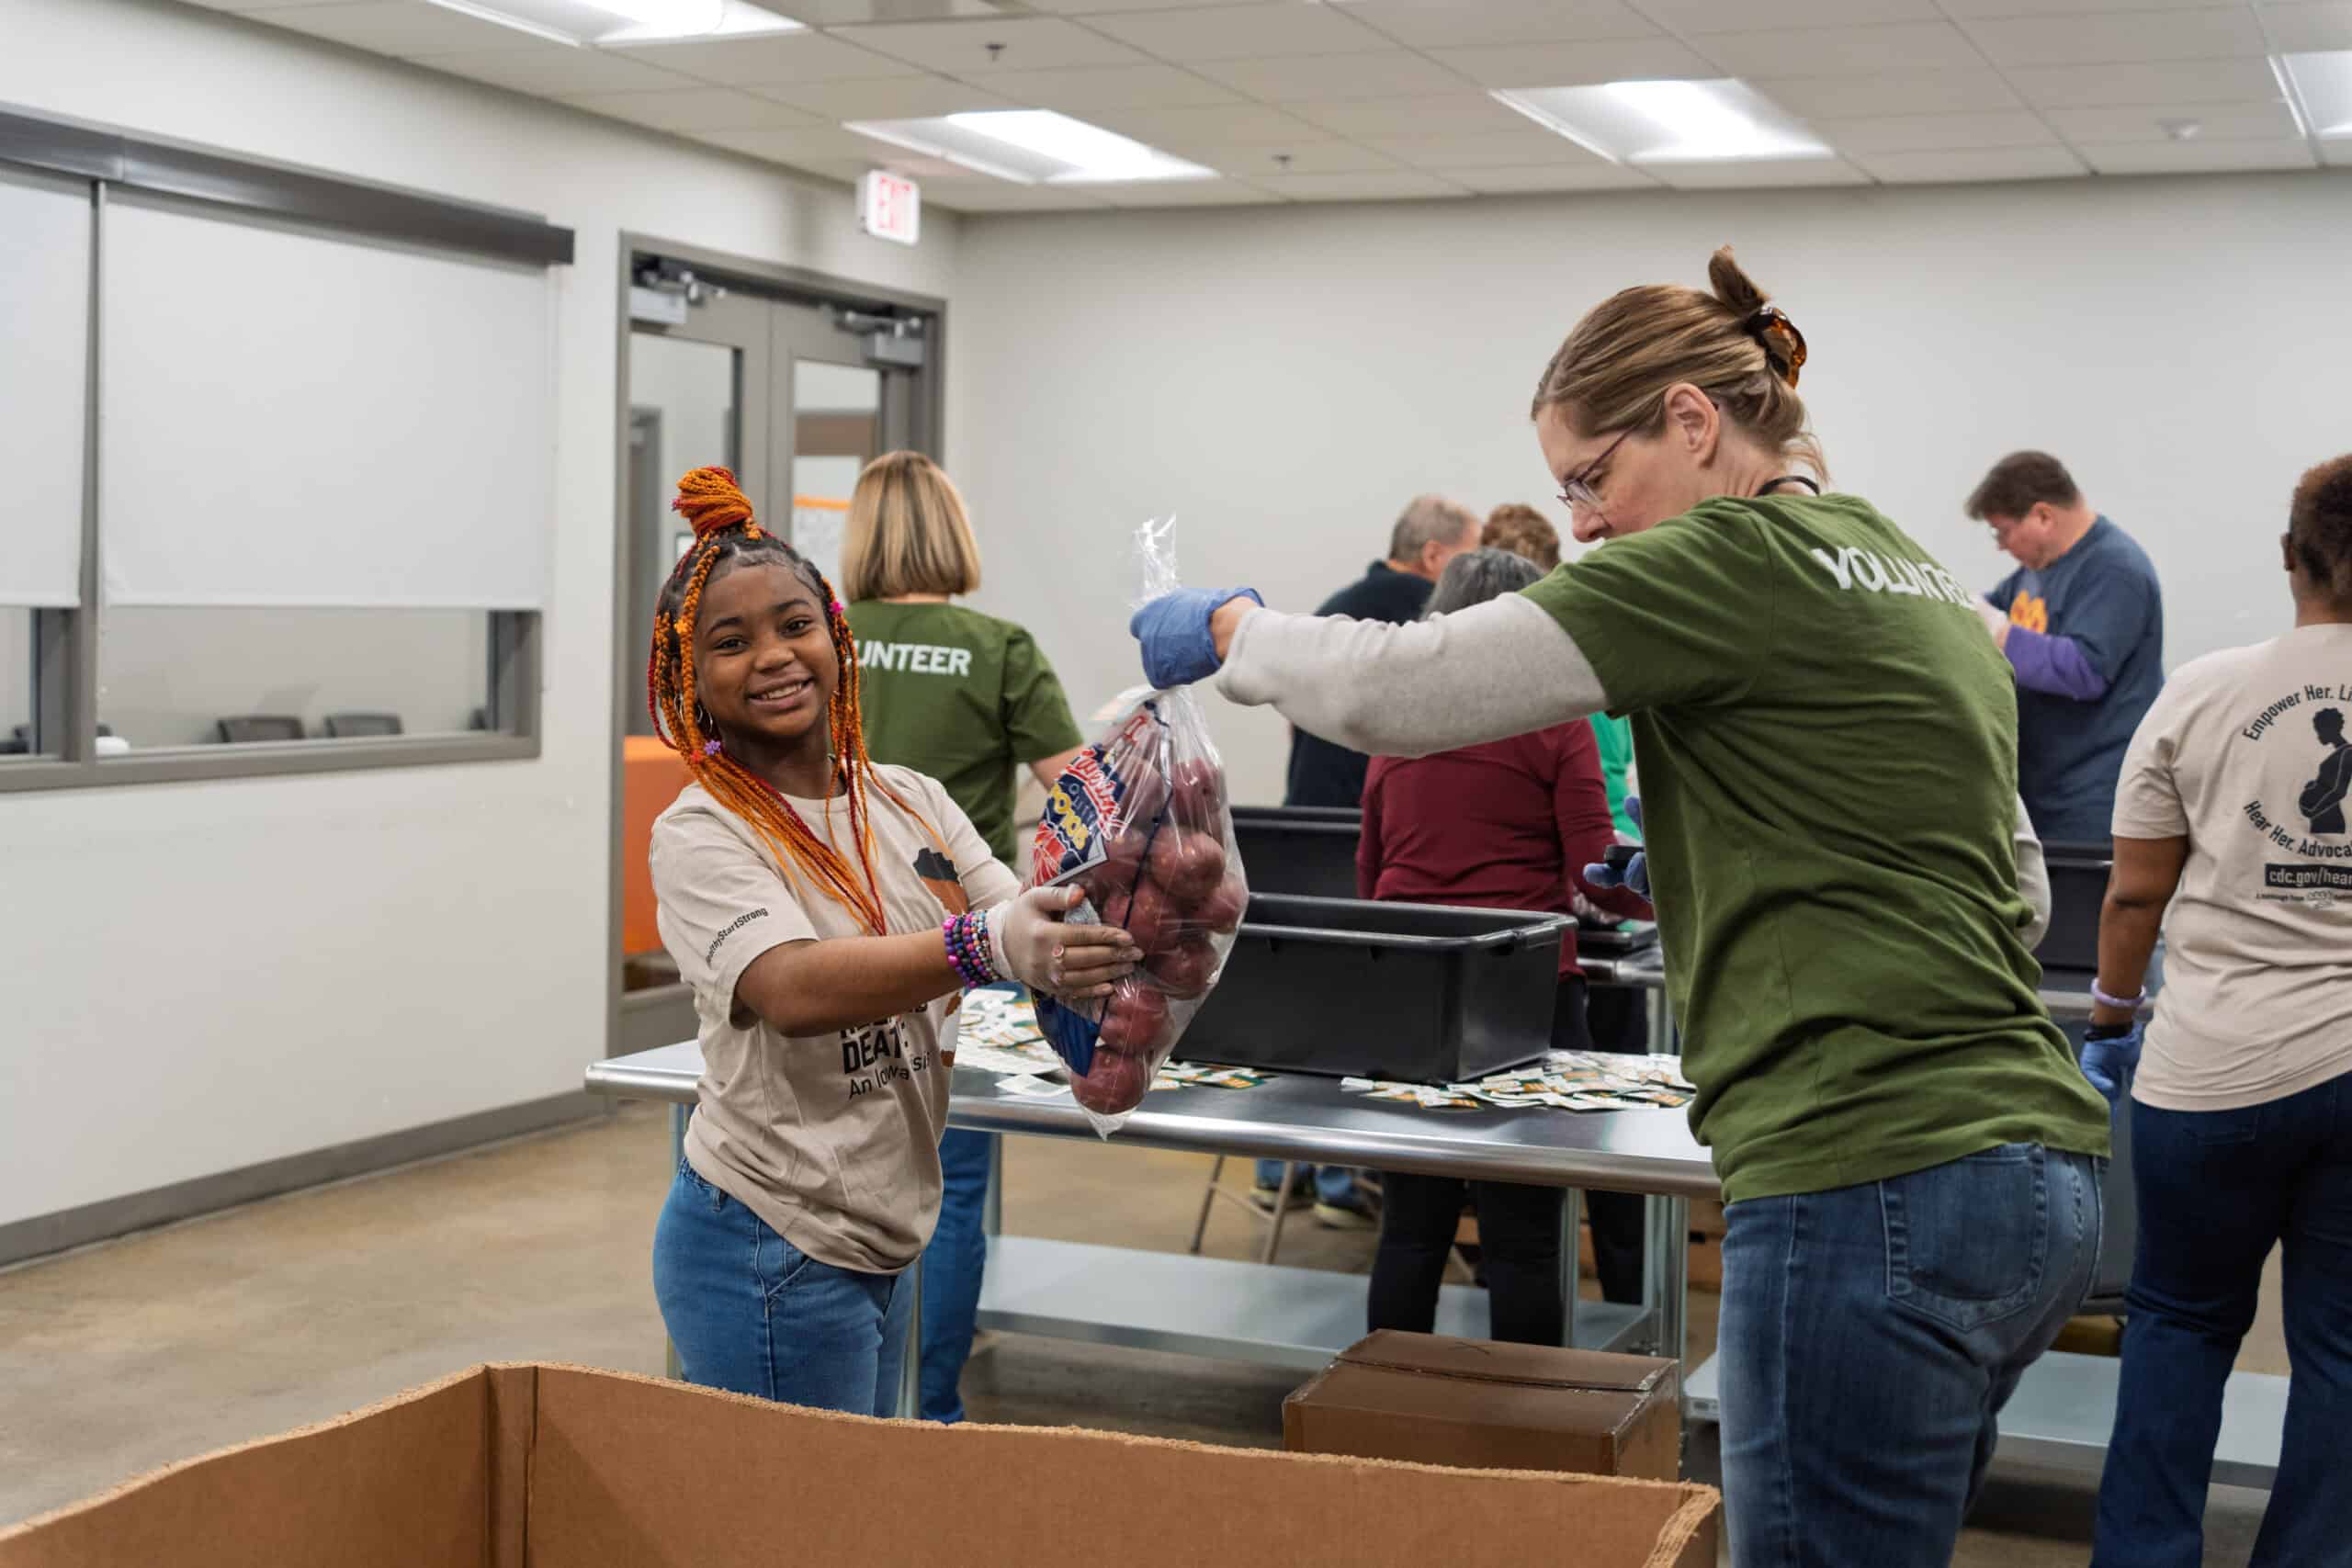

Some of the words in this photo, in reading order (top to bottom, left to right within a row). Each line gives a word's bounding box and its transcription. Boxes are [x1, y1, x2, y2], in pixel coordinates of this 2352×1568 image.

[845, 639, 972, 677] UNTEER
[2243, 693, 2301, 740] Empower
[2304, 684, 2335, 701] Her.
[2338, 683, 2352, 702] Li
[2244, 801, 2272, 831] Hear
[2269, 825, 2296, 851] Her.
[2298, 839, 2352, 858] Advoca
[2269, 868, 2352, 887] cdc.gov/hear
[842, 1026, 903, 1075] DEAT
[849, 1078, 872, 1100] An
[875, 1066, 910, 1089] Iowa
